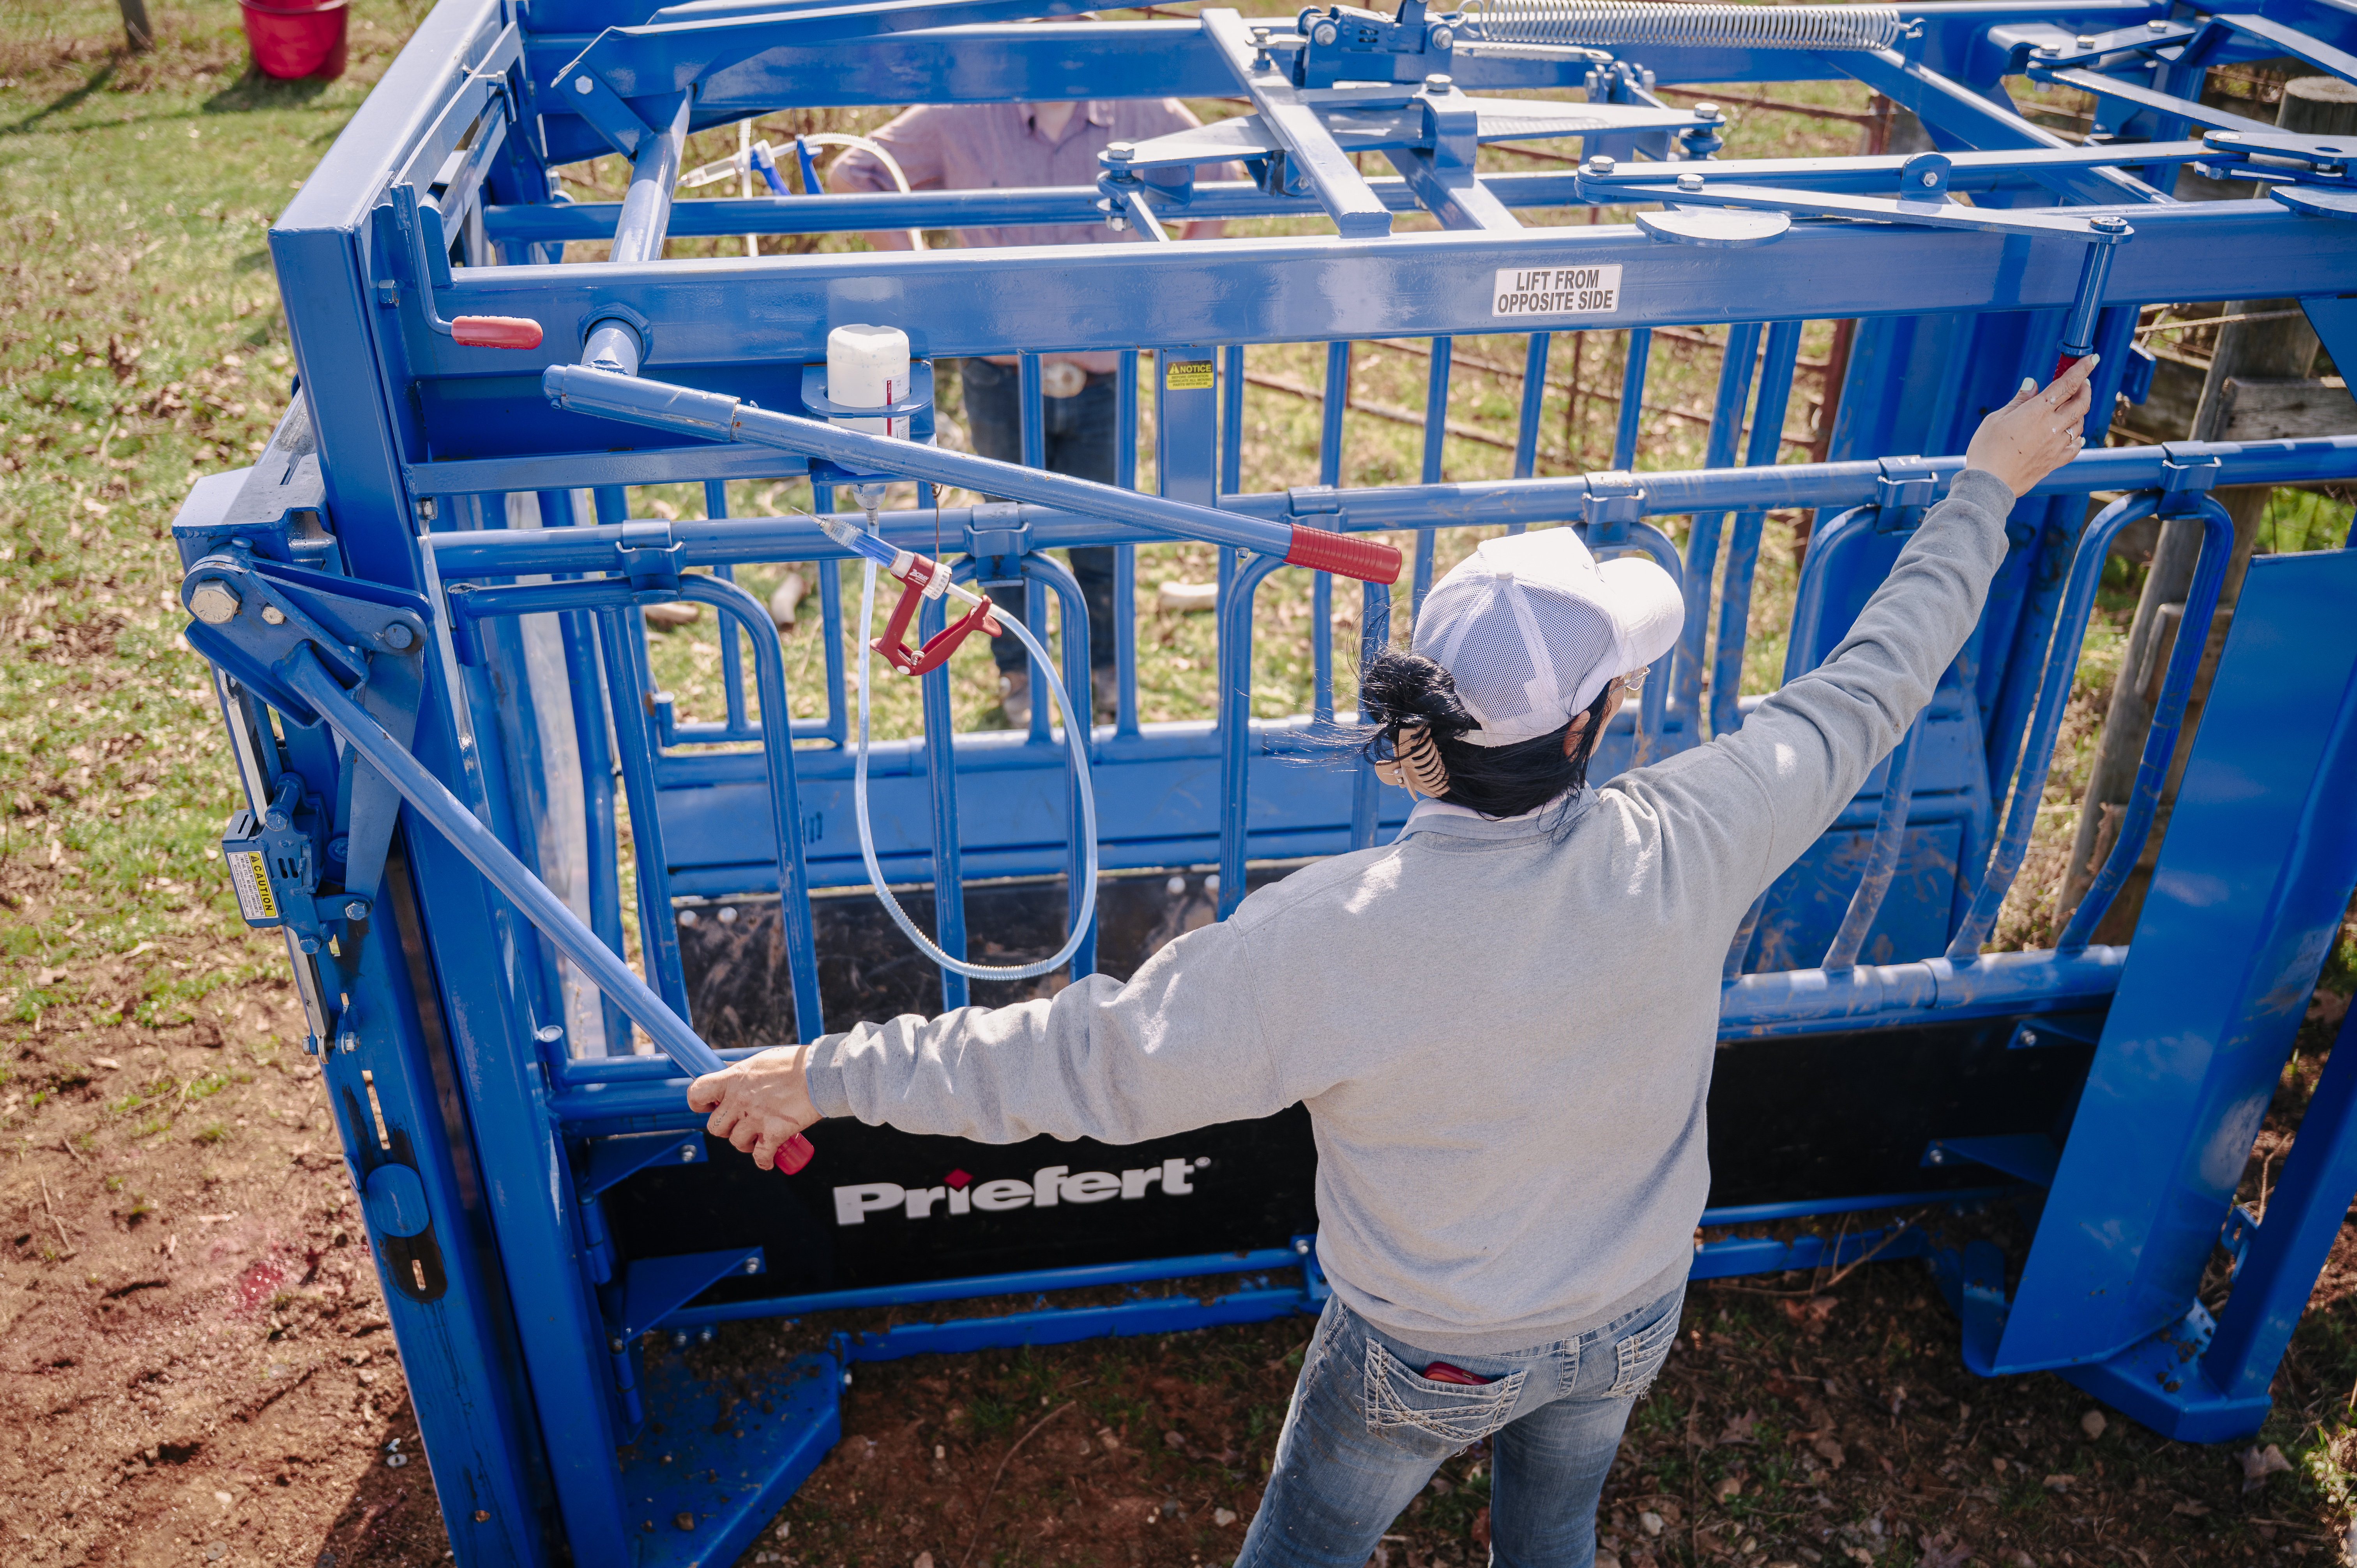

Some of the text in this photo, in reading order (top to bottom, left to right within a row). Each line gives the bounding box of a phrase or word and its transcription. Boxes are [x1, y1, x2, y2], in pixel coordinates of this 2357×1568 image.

[1516, 269, 1599, 291] LIFT FROM
[1498, 290, 1613, 313] OPPOSITE SIDE
[1180, 364, 1211, 373] NOTICE
[909, 569, 929, 582] ZACTRAN
[253, 865, 273, 910] CAUTION
[254, 892, 263, 910] LUBRICATING
